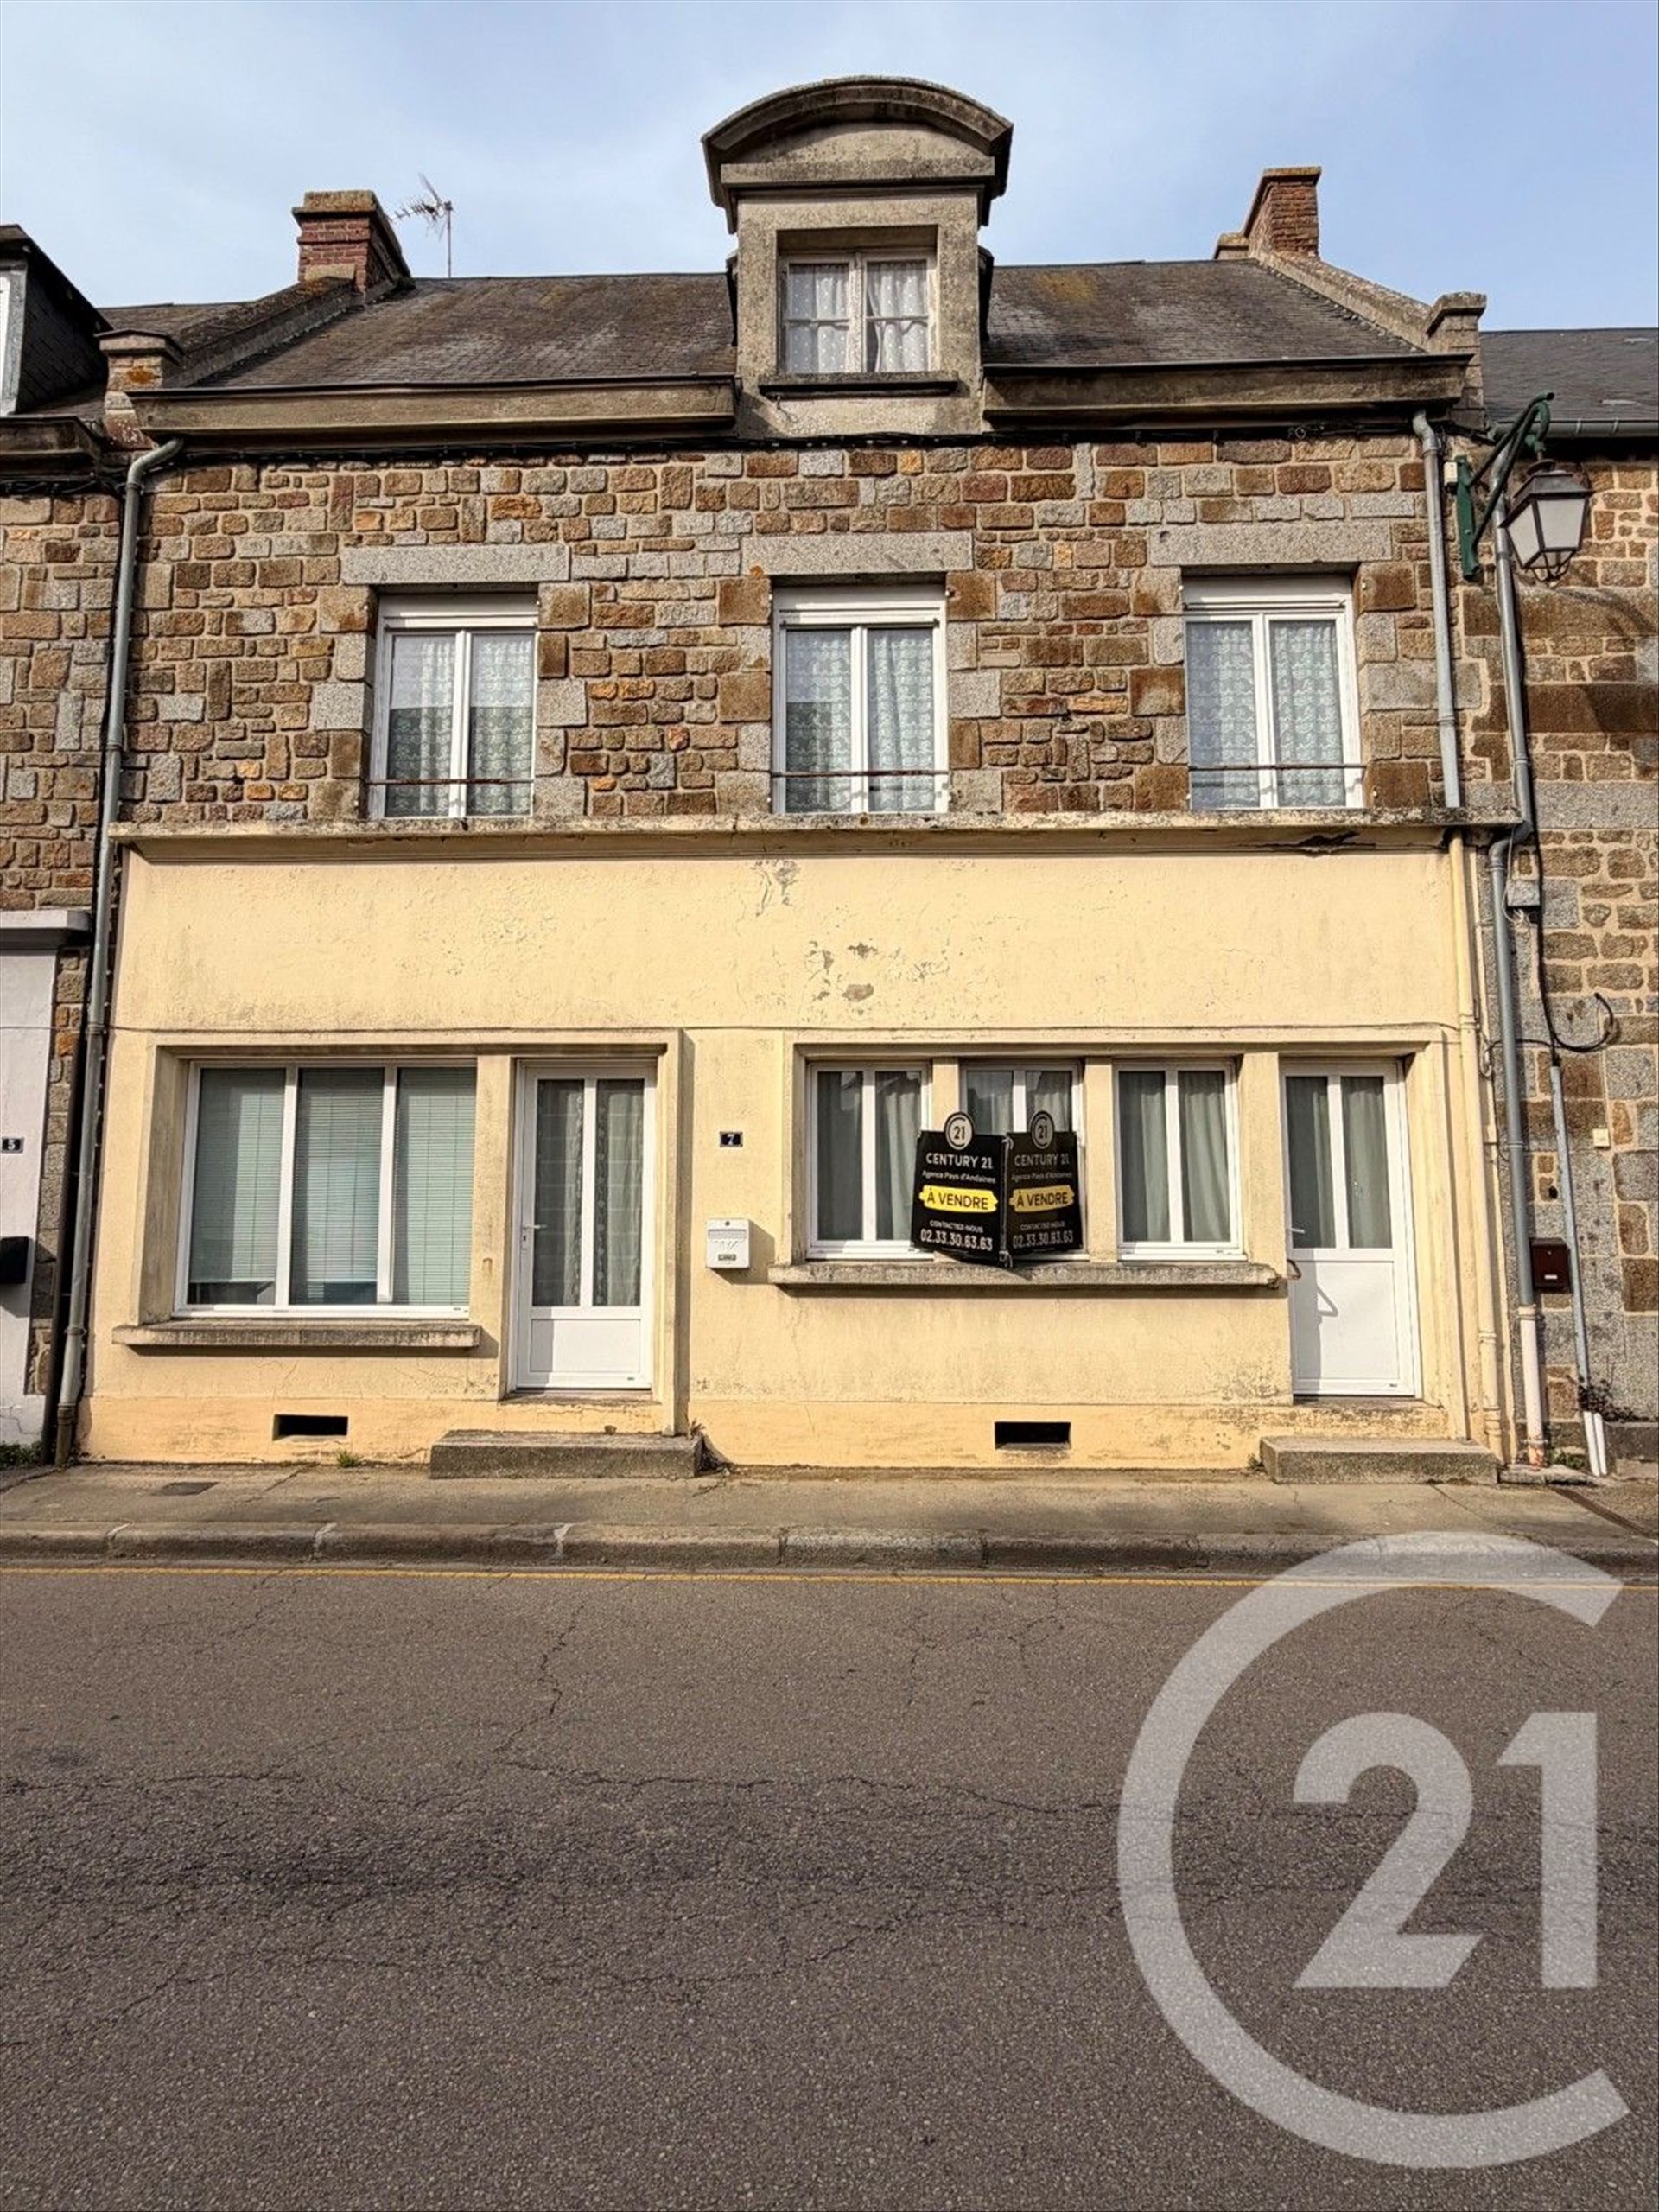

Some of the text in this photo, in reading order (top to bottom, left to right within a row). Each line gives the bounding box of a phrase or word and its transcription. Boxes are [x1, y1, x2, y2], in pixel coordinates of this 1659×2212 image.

[953, 1126, 966, 1140] 21
[1038, 1125, 1048, 1139] 21
[8, 1139, 16, 1150] 5
[726, 1134, 734, 1145] 7
[925, 1152, 994, 1169] CENTURY 21
[1014, 1153, 1071, 1166] CENTURY 21
[922, 1170, 996, 1184] Agence Pays d'Andaines
[927, 1187, 988, 1210] À VENDRE
[1016, 1191, 1068, 1207] À VENDRE
[920, 1228, 993, 1251] 02.33.30.63.63
